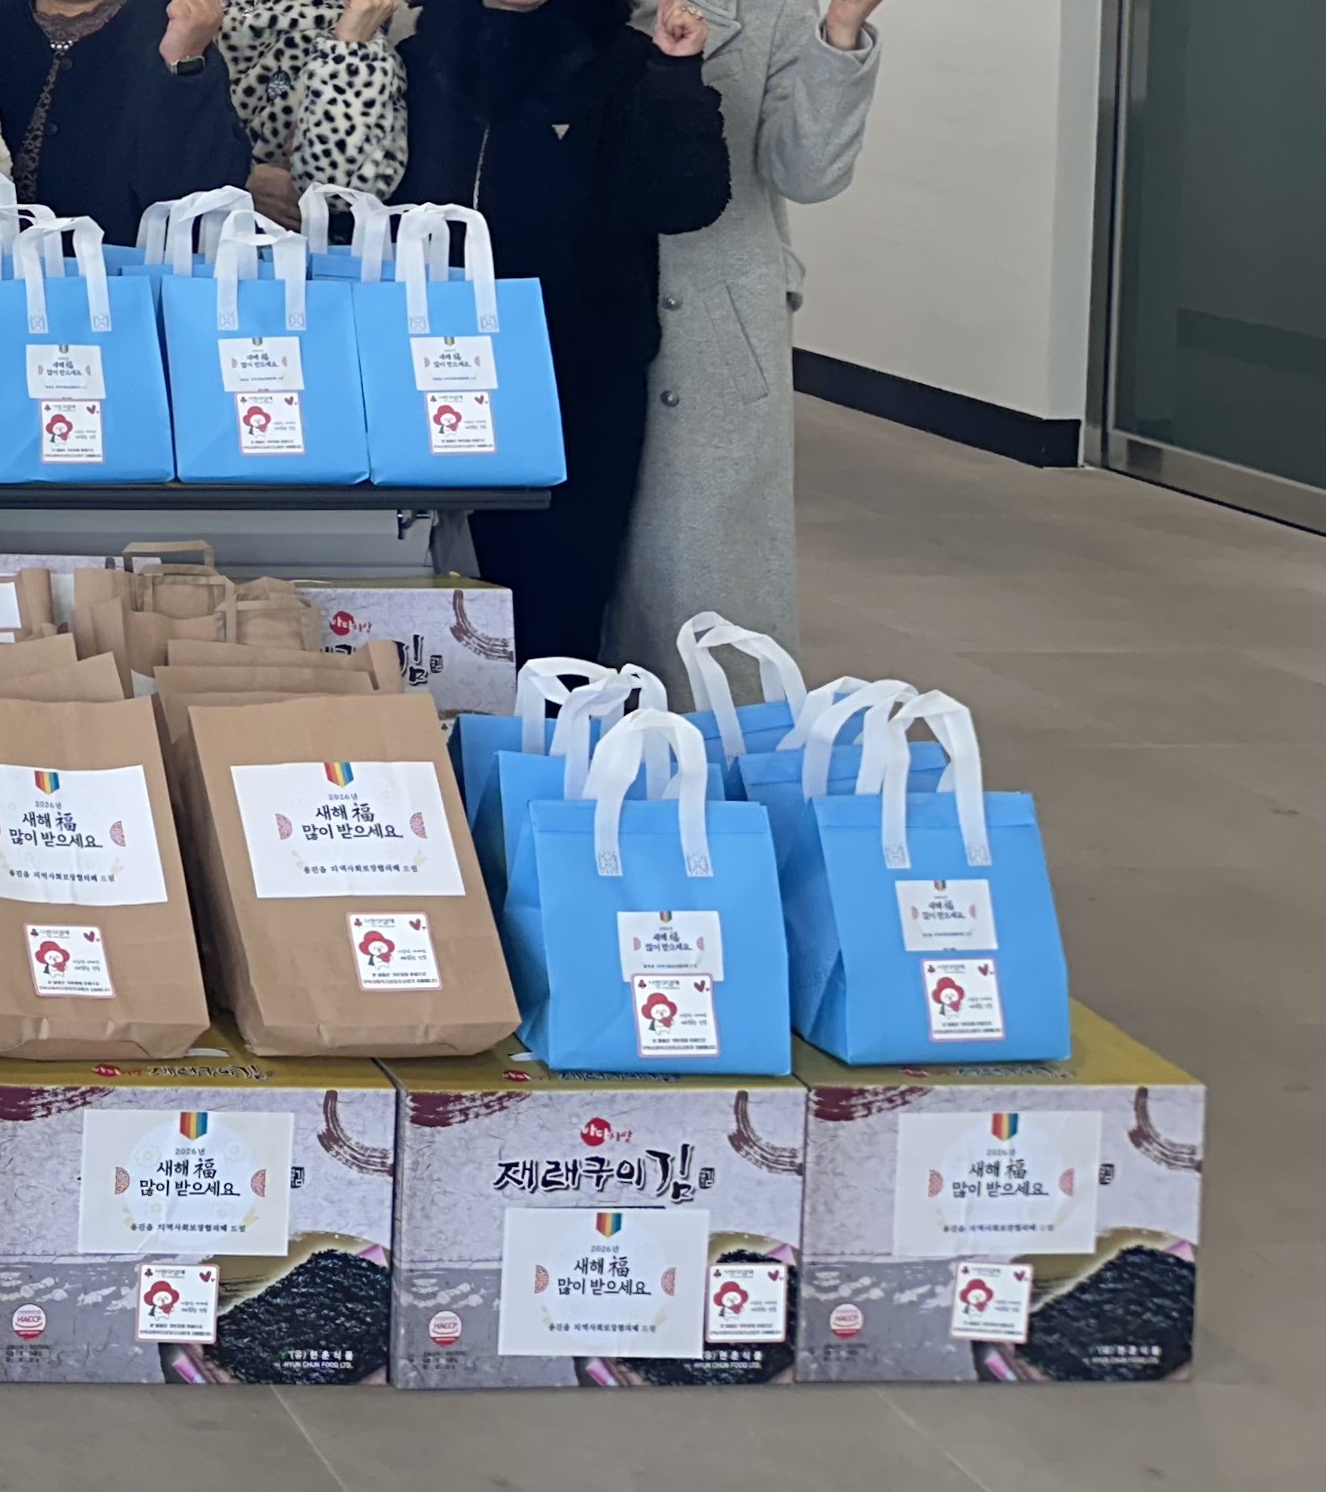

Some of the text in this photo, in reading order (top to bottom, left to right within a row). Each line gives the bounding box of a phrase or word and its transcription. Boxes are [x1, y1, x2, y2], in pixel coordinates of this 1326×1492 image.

[22, 810, 77, 832] 새해 福
[315, 801, 375, 823] 새해 福
[9, 828, 103, 849] 많이 받으세요.
[302, 823, 403, 841] 많이 받으세요.
[175, 1147, 205, 1156] 2026년
[156, 1158, 216, 1179] 새해 福
[493, 1144, 695, 1205] 재래구이김
[969, 1158, 1027, 1179] 새해 福
[140, 1179, 240, 1197] 많이 받으세요.
[952, 1180, 1049, 1197] 많이 받으세요.
[591, 1245, 620, 1253] 2026년
[574, 1256, 630, 1277] 새해 福
[557, 1279, 651, 1296] 많이 받으세요.
